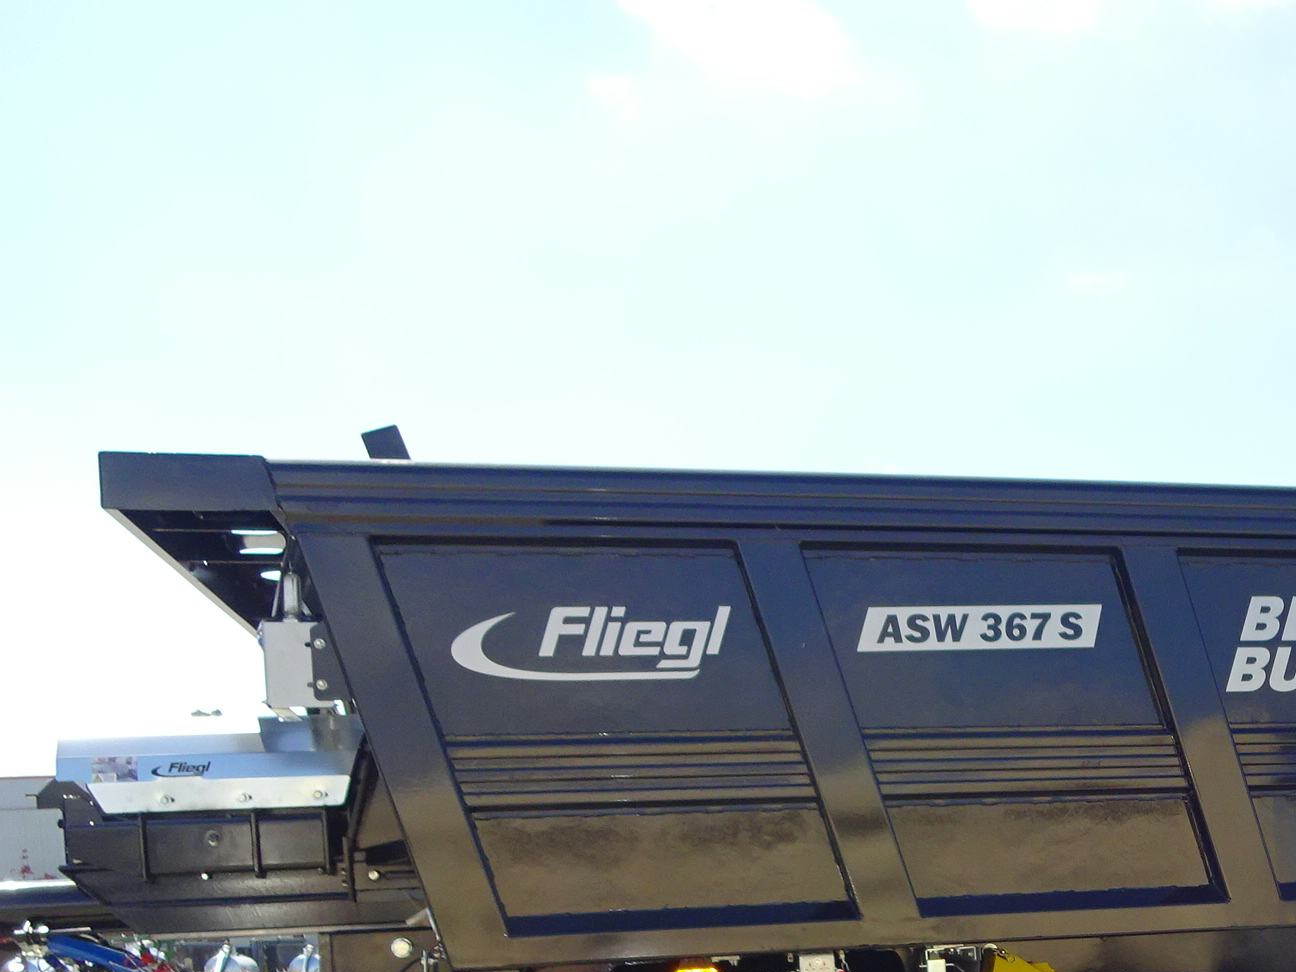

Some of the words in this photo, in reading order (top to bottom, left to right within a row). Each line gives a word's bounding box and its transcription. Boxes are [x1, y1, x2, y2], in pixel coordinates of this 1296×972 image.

[538, 606, 731, 668] Fliegl
[876, 613, 969, 644] ASW
[979, 612, 1052, 642] 367
[1058, 611, 1083, 641] S
[168, 760, 211, 776] Fliegl
